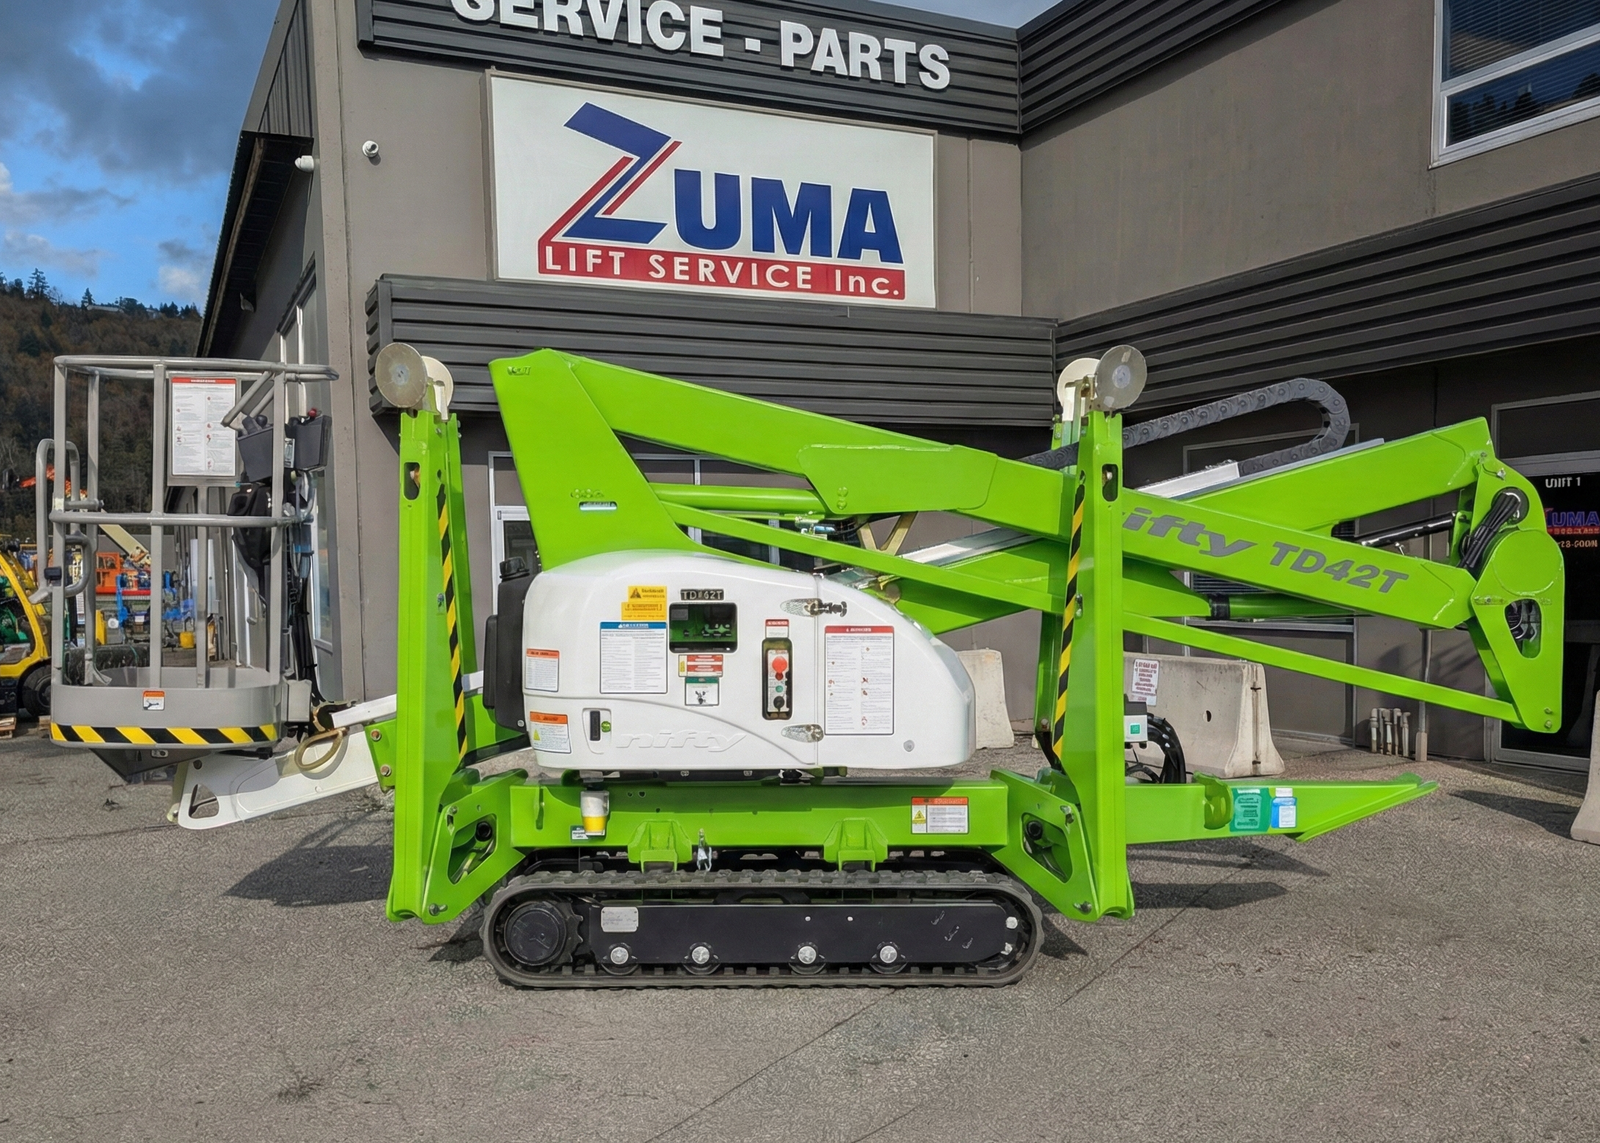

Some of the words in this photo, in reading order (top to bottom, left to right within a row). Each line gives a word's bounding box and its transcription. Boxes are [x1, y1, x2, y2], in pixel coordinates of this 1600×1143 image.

[780, 20, 950, 90] PARTS
[560, 101, 904, 265] ZUMA
[545, 245, 625, 276] LIFT
[648, 254, 812, 289] SERVICE
[835, 269, 899, 296] Inc.
[1122, 506, 1259, 557] ifty
[1269, 541, 1410, 594] TD42T
